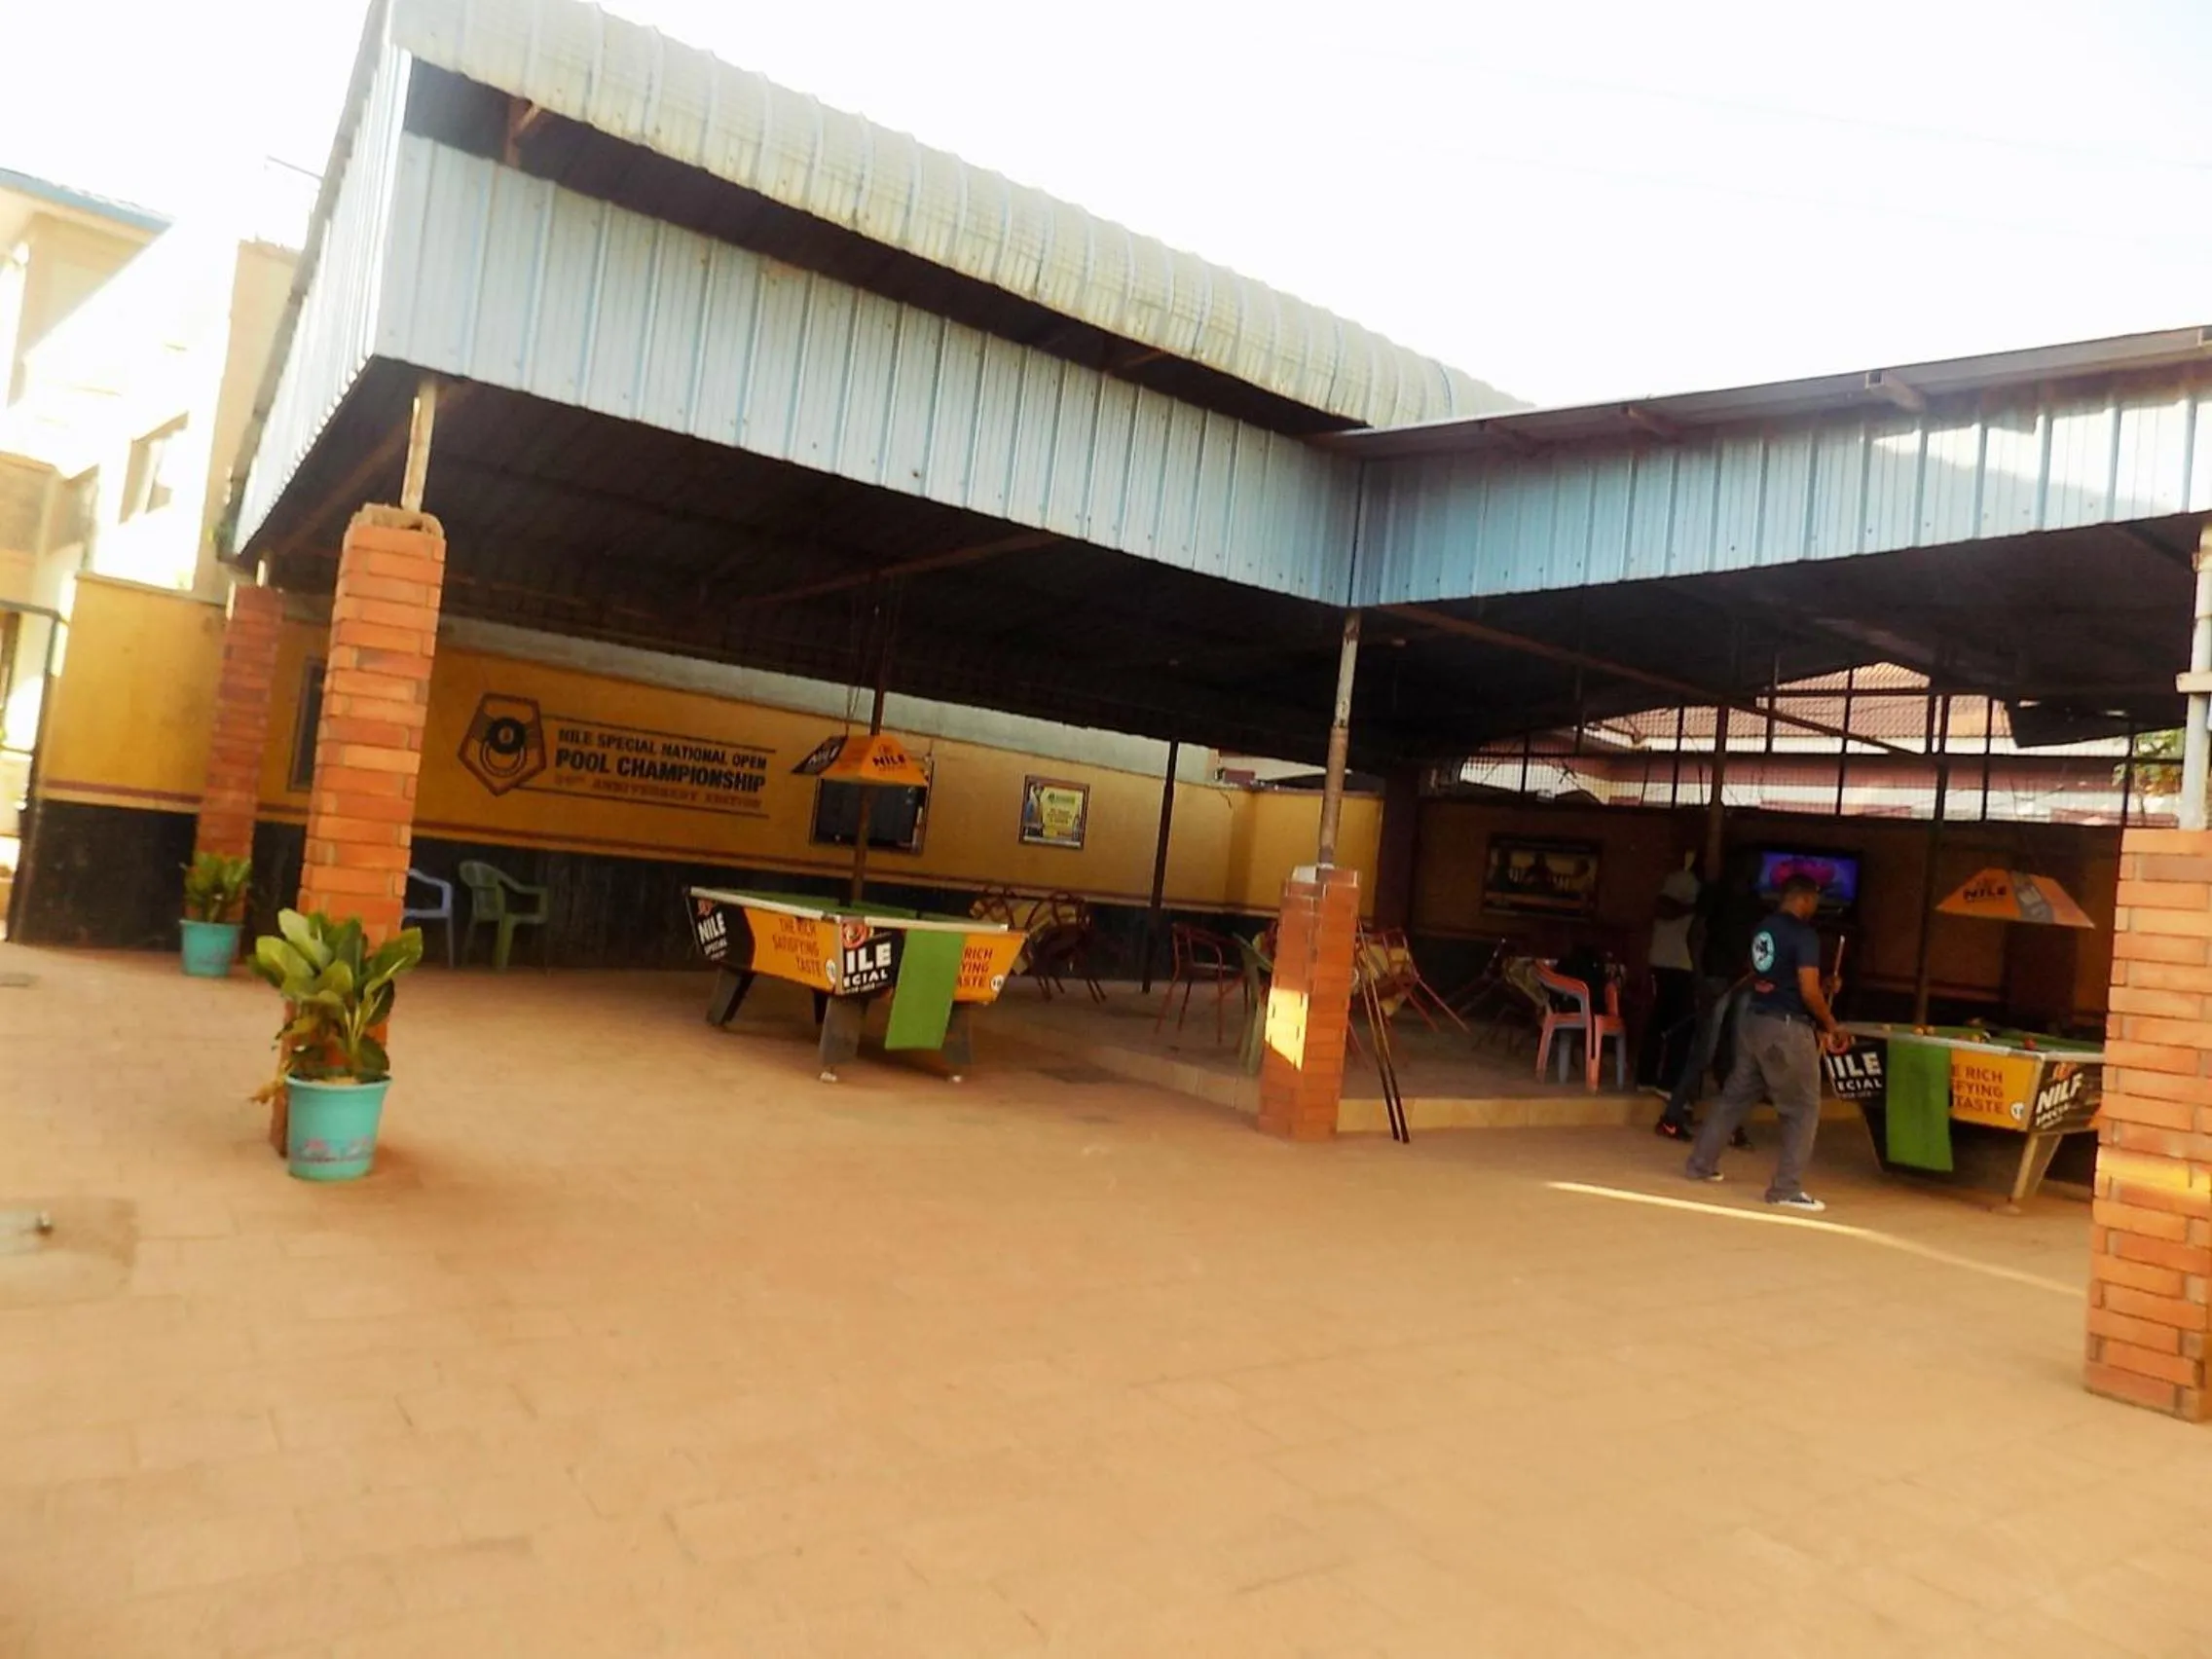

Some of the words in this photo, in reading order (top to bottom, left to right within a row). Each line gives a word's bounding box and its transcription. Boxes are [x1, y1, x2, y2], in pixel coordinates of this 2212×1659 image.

[558, 727, 591, 747] NILE
[597, 733, 656, 755] SPECIAL
[661, 743, 727, 766] NATIONAL
[732, 753, 767, 770] OPEN
[555, 748, 610, 773] POOL
[617, 756, 766, 793] CHAMPIONSHIP
[1963, 885, 2007, 902] NILE
[845, 941, 893, 976] ILE
[964, 945, 993, 960] RICH
[843, 968, 889, 988] ECIAL
[1965, 1064, 2004, 1084] RICH
[1836, 1078, 1884, 1092] ECIAL
[1953, 1080, 2004, 1100] FYING
[1954, 1094, 2004, 1115] TASTE
